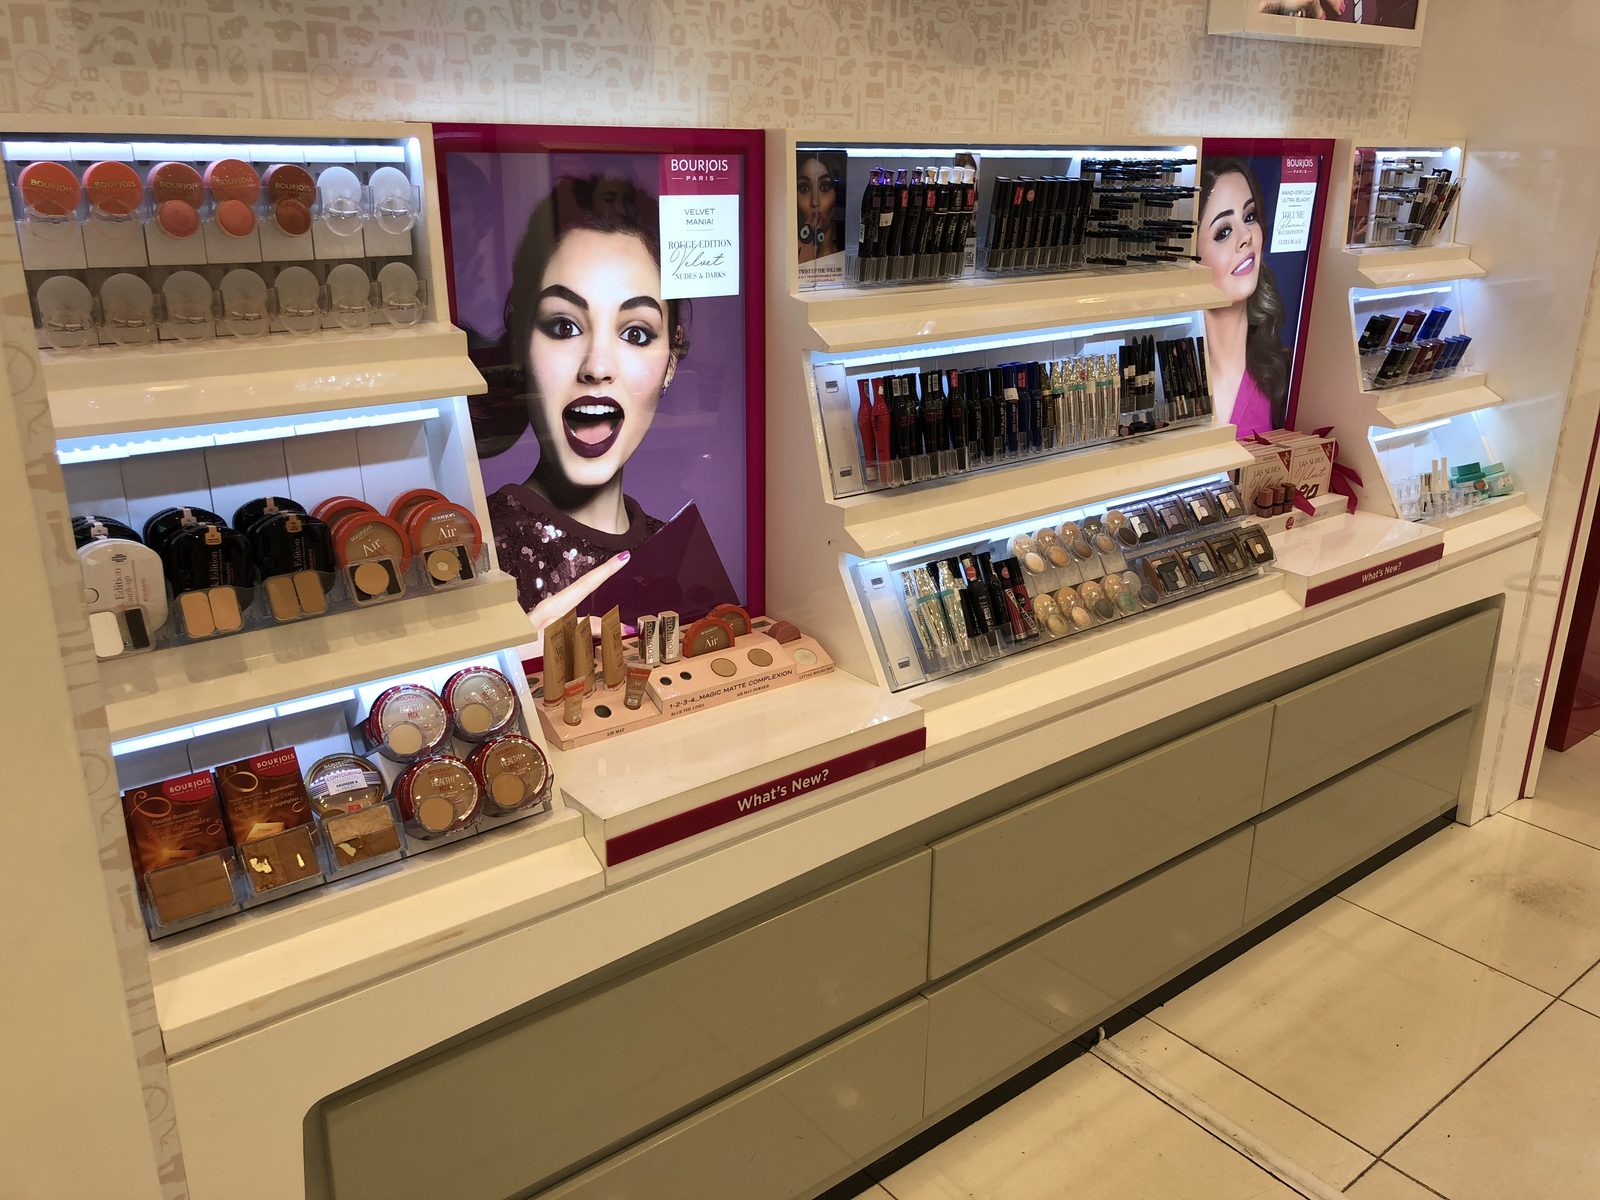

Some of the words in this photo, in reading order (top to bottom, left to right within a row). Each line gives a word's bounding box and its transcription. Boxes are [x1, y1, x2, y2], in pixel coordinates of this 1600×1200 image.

[671, 158, 729, 174] BOURJOIS
[1286, 158, 1314, 169] BOURJOIS
[30, 178, 74, 193] BOURJOIS
[94, 180, 136, 189] BOURJOIS
[159, 181, 200, 191] BOURJOIS
[216, 176, 254, 186] BOURJOIS
[274, 182, 312, 192] BOURJOIS
[683, 208, 716, 216] VELVET
[686, 218, 714, 226] MANIA!
[668, 240, 698, 250] ROUGE
[699, 239, 732, 249] EDITION
[670, 244, 725, 277] Velvet
[674, 272, 698, 281] NUDES
[705, 271, 727, 280] DARKS
[438, 524, 457, 540] Air
[292, 538, 303, 568] Edition
[362, 539, 382, 558] Air
[209, 551, 219, 581] Edition
[1361, 568, 1384, 584] What's
[1384, 561, 1402, 575] New?
[113, 567, 125, 600] Edition
[705, 636, 719, 648] Air
[723, 681, 747, 694] MATTE
[748, 668, 793, 687] COMPLEXION
[480, 682, 499, 701] HEALTHY
[400, 703, 424, 713] HEALTHY
[256, 752, 296, 769] BOURJOIS
[500, 753, 523, 768] HEALTHY
[169, 777, 211, 793] BOURJOIS
[431, 776, 456, 787] HEALTHY
[737, 785, 787, 812] What's
[792, 768, 829, 793] New?
